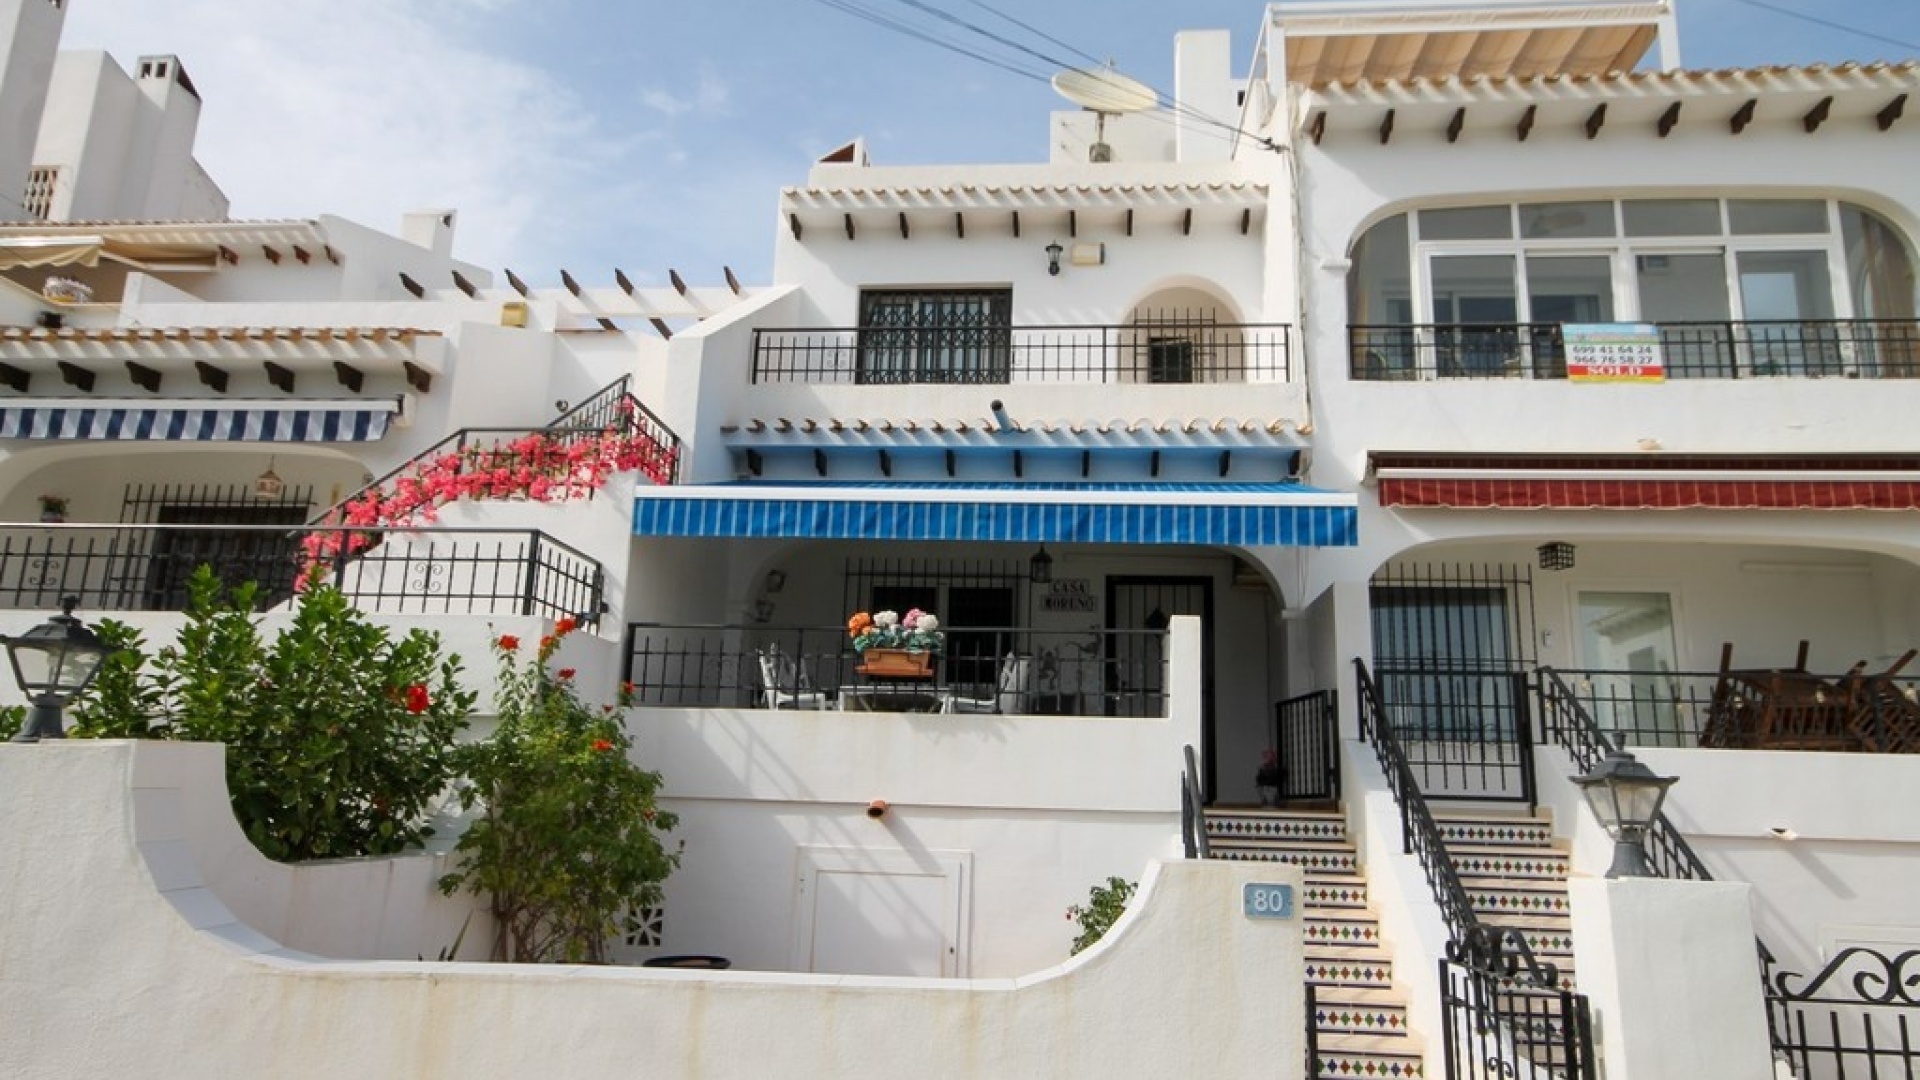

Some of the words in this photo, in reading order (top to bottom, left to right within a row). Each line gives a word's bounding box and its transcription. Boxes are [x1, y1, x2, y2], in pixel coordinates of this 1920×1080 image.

[1573, 345, 1595, 354] 699
[1599, 345, 1613, 354] 41
[1618, 345, 1633, 354] 64
[1638, 345, 1653, 354] 24
[1574, 355, 1596, 364] 966
[1601, 355, 1616, 364] 76
[1619, 355, 1634, 364] 58
[1638, 355, 1653, 364] 27
[1588, 365, 1643, 375] SOLD
[1053, 579, 1086, 593] CASA
[1045, 596, 1094, 610] MORENO
[1253, 889, 1283, 912] 80
